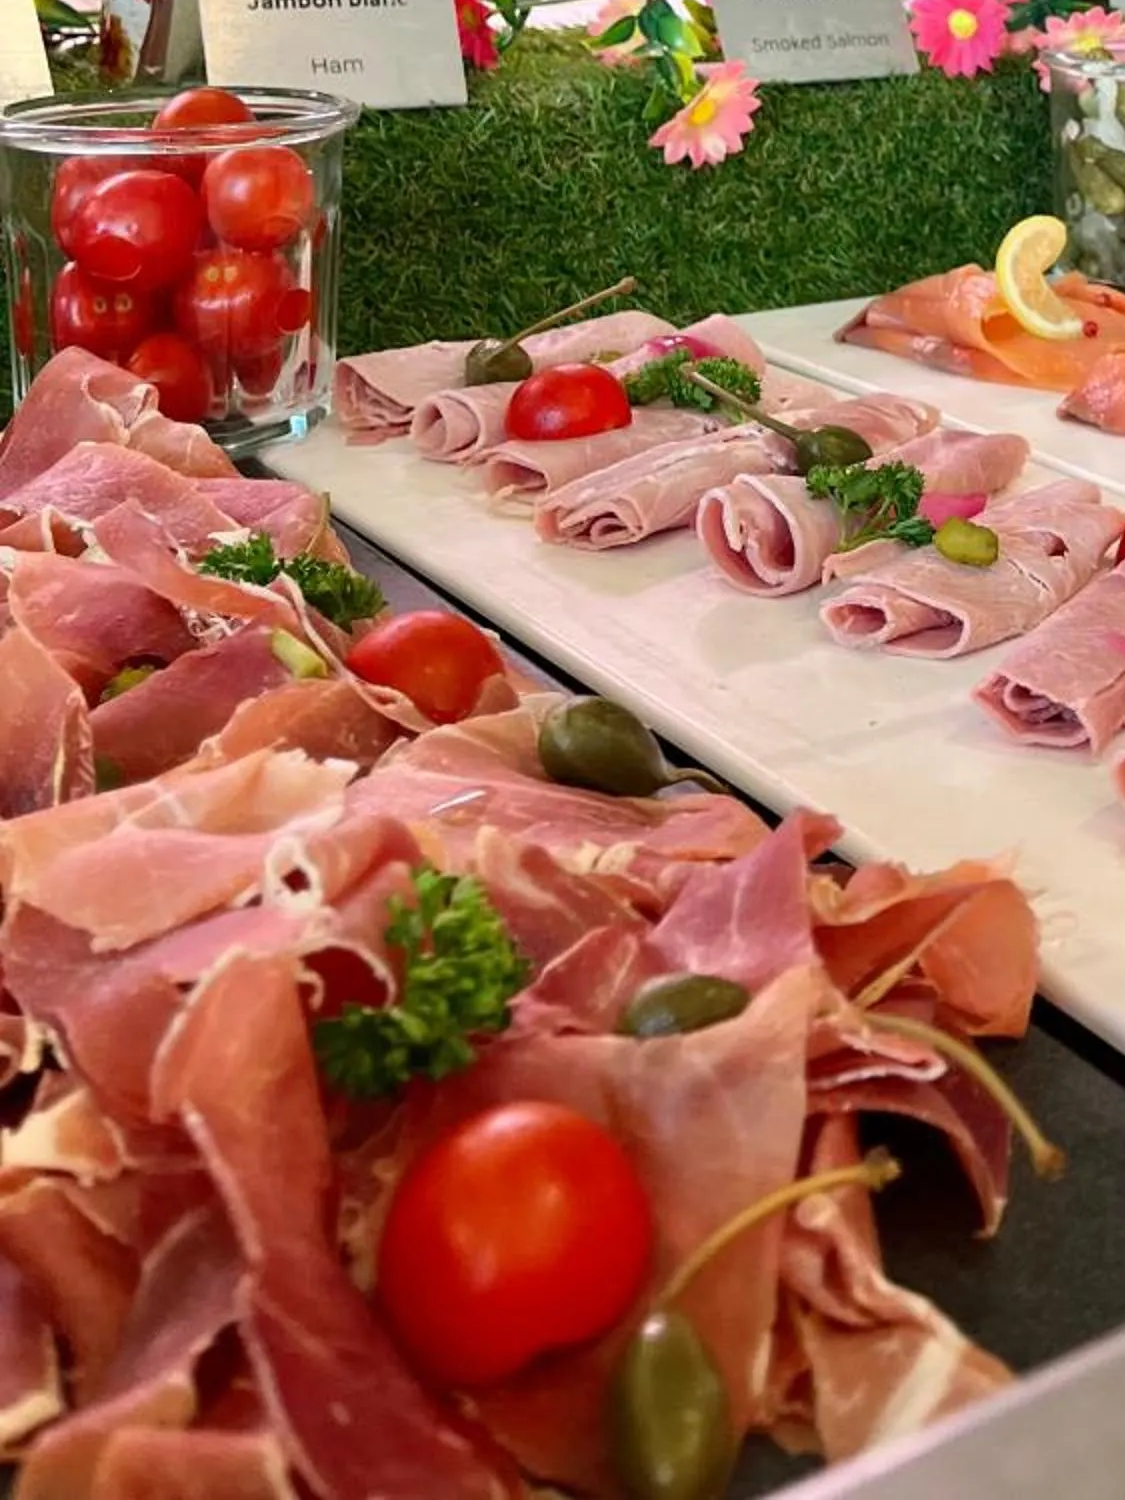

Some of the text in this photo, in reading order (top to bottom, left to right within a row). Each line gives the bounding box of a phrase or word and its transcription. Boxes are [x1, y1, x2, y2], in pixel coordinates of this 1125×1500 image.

[752, 30, 890, 53] Smoked Salmon
[311, 57, 365, 75] Ham
